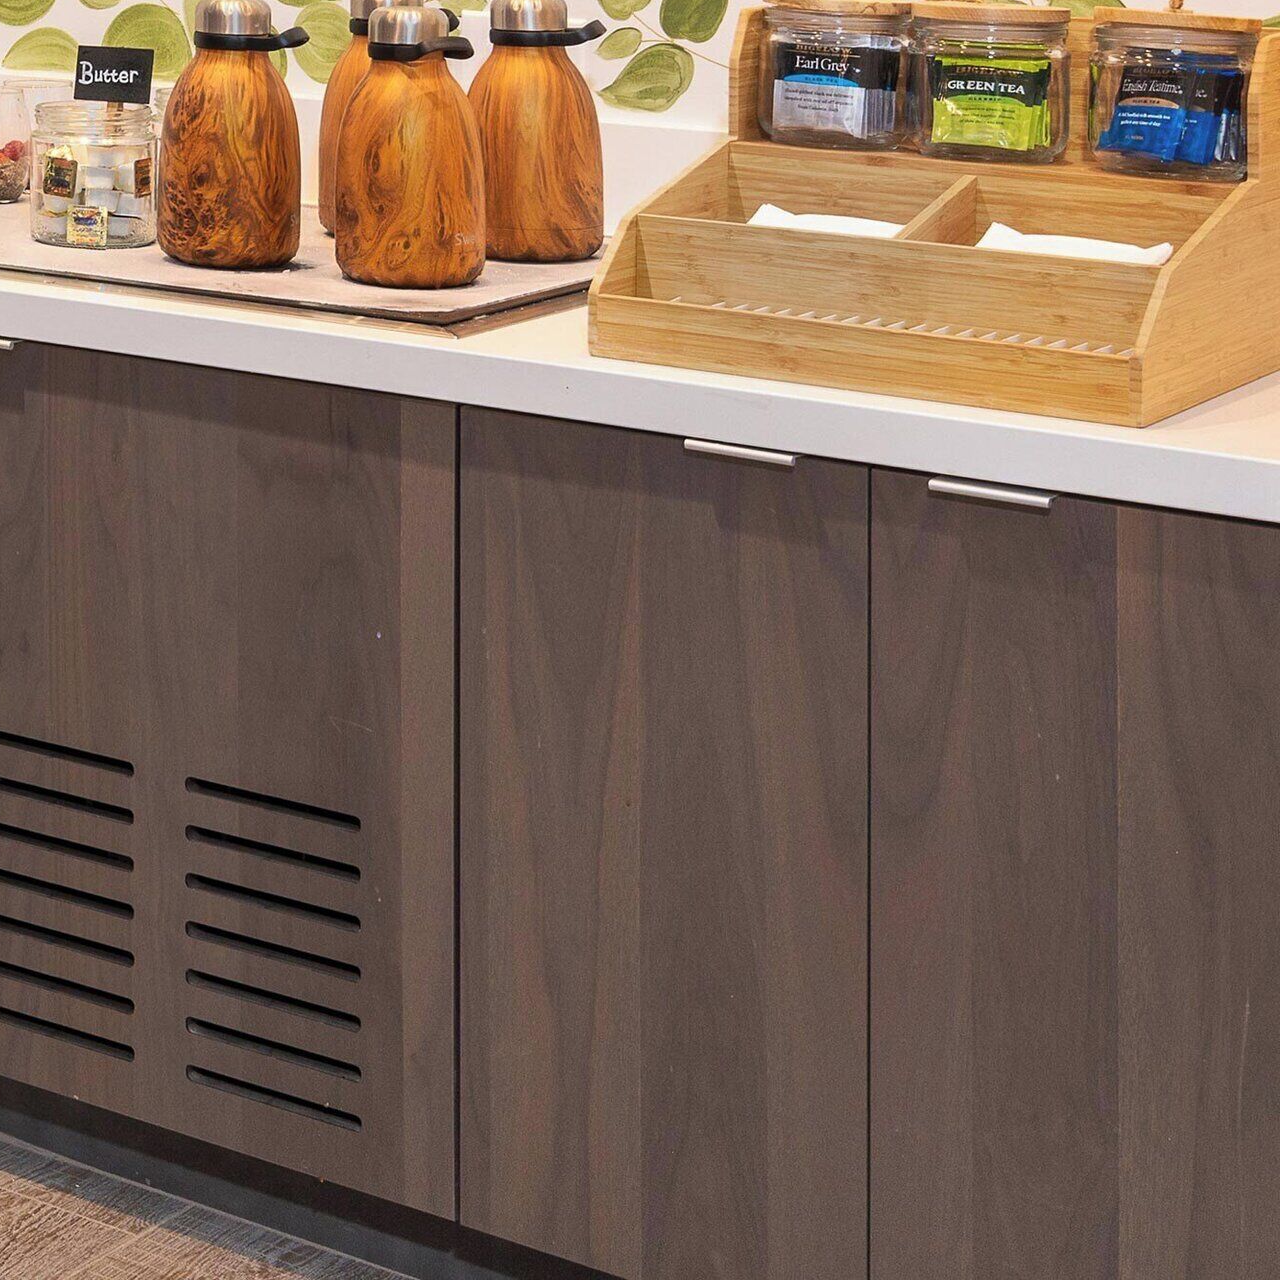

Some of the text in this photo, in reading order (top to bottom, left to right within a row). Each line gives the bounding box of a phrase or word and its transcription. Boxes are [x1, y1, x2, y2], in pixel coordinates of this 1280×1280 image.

[795, 55, 850, 72] Earl Grey
[78, 61, 139, 85] Butter
[947, 79, 1026, 95] GREEN TEA
